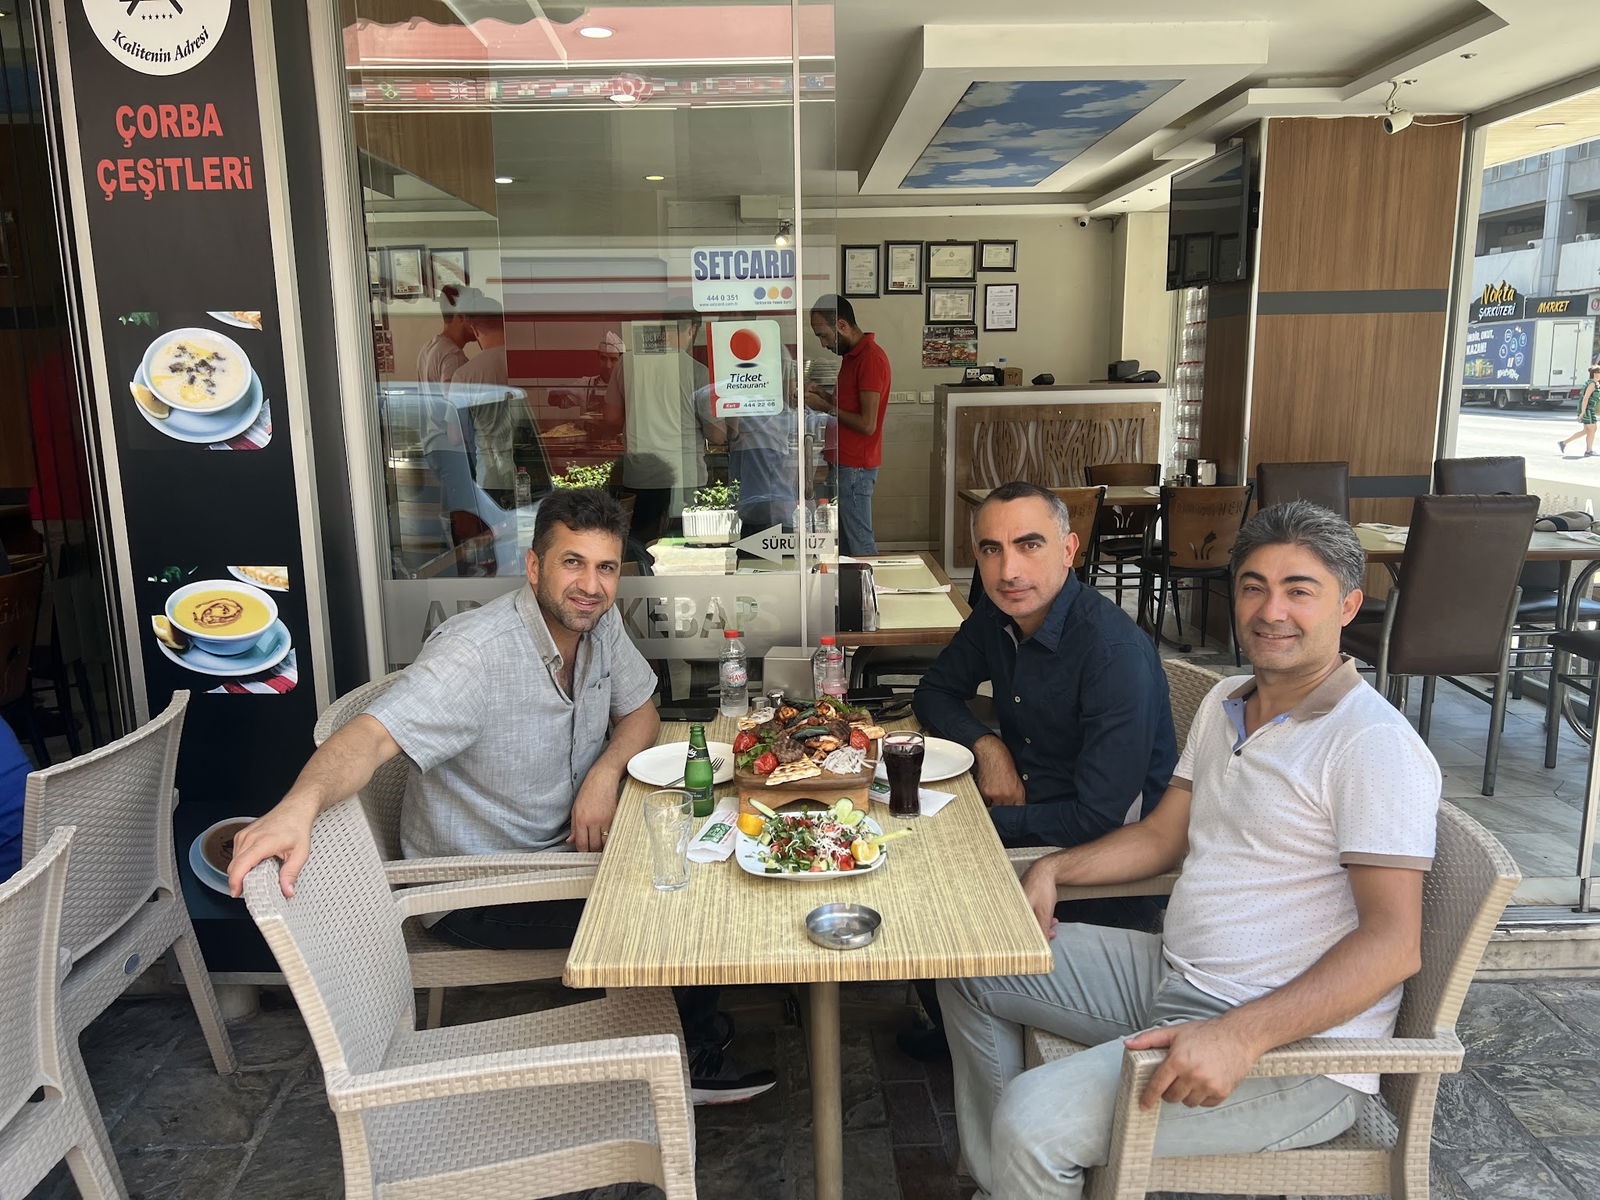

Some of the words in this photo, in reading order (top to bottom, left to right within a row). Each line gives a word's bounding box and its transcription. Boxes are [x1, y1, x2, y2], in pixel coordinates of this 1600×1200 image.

[112, 30, 172, 62] Kalitenin
[174, 25, 210, 61] Adresi
[115, 103, 224, 148] ÇORBA
[693, 249, 795, 281] SETCARD
[1480, 280, 1516, 304] Nokta
[1536, 300, 1570, 313] MARKET
[726, 381, 767, 389] Restaurant
[729, 373, 762, 383] Ticket
[762, 535, 826, 550] SÜRÜÜZ
